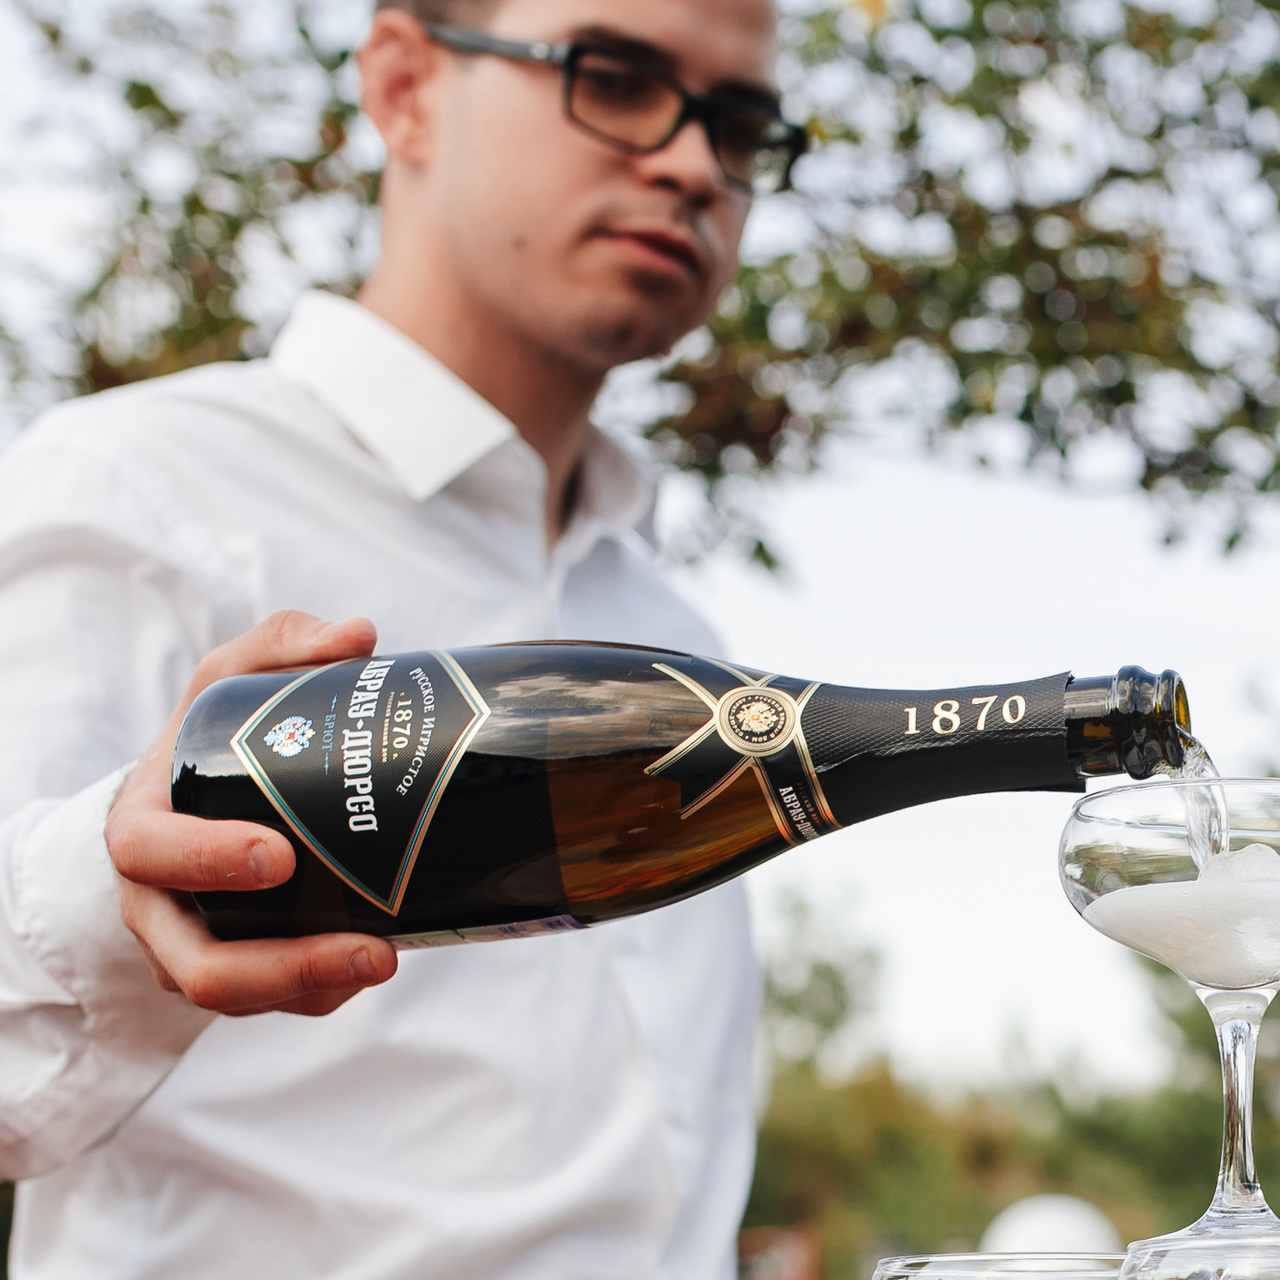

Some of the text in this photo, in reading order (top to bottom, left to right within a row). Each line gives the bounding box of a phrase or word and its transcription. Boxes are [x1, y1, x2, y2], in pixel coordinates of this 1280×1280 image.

[322, 714, 337, 752] БРЮТ
[392, 699, 413, 749] 1870
[904, 695, 1027, 735] 1870
